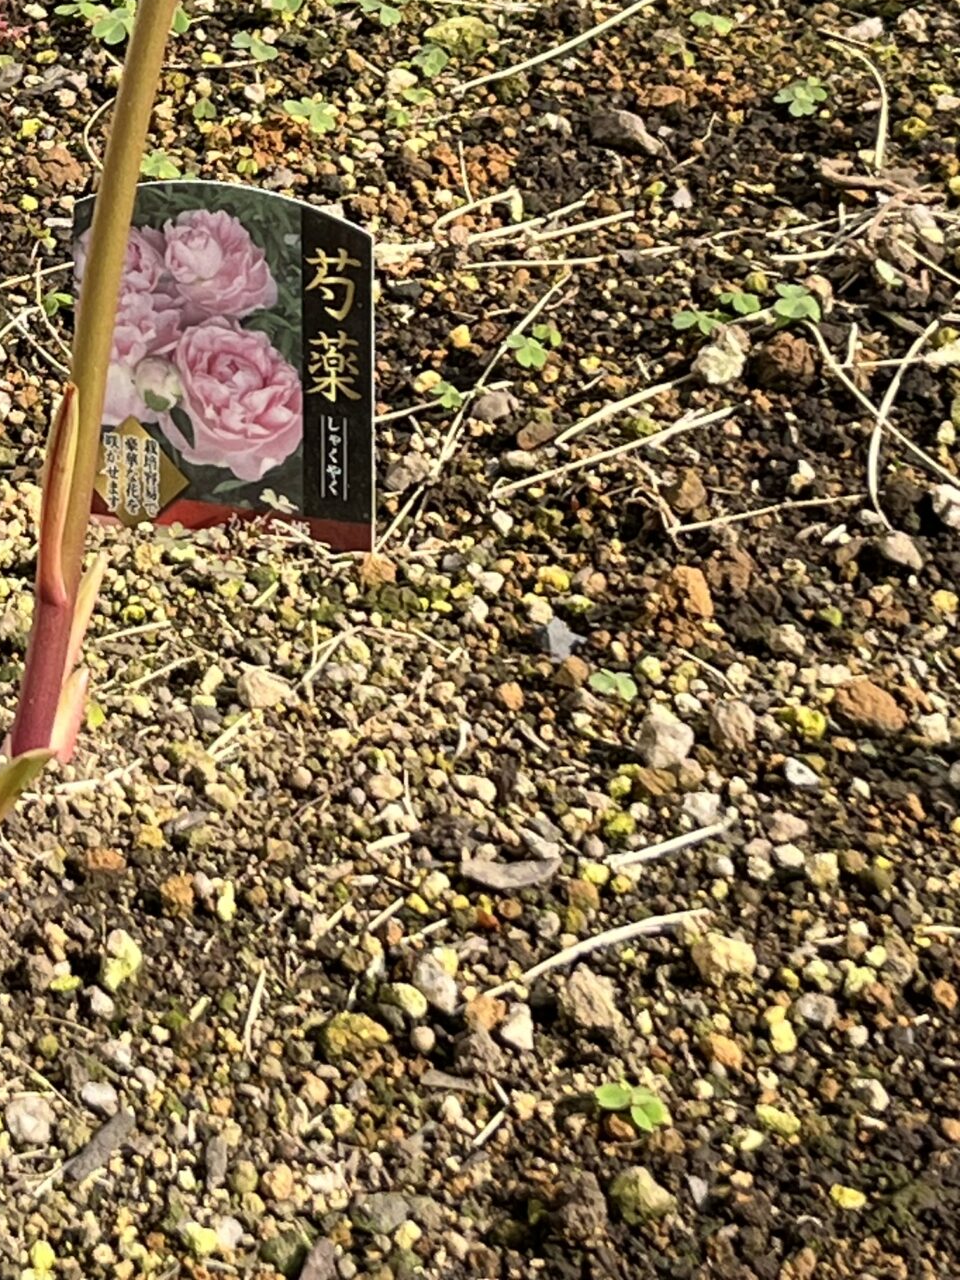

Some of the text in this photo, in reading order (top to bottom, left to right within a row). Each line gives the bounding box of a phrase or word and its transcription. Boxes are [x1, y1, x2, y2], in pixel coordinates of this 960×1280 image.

[304, 246, 363, 403] 芍薬
[104, 434, 121, 509] 咲かせます
[326, 415, 343, 497] しゃくやく
